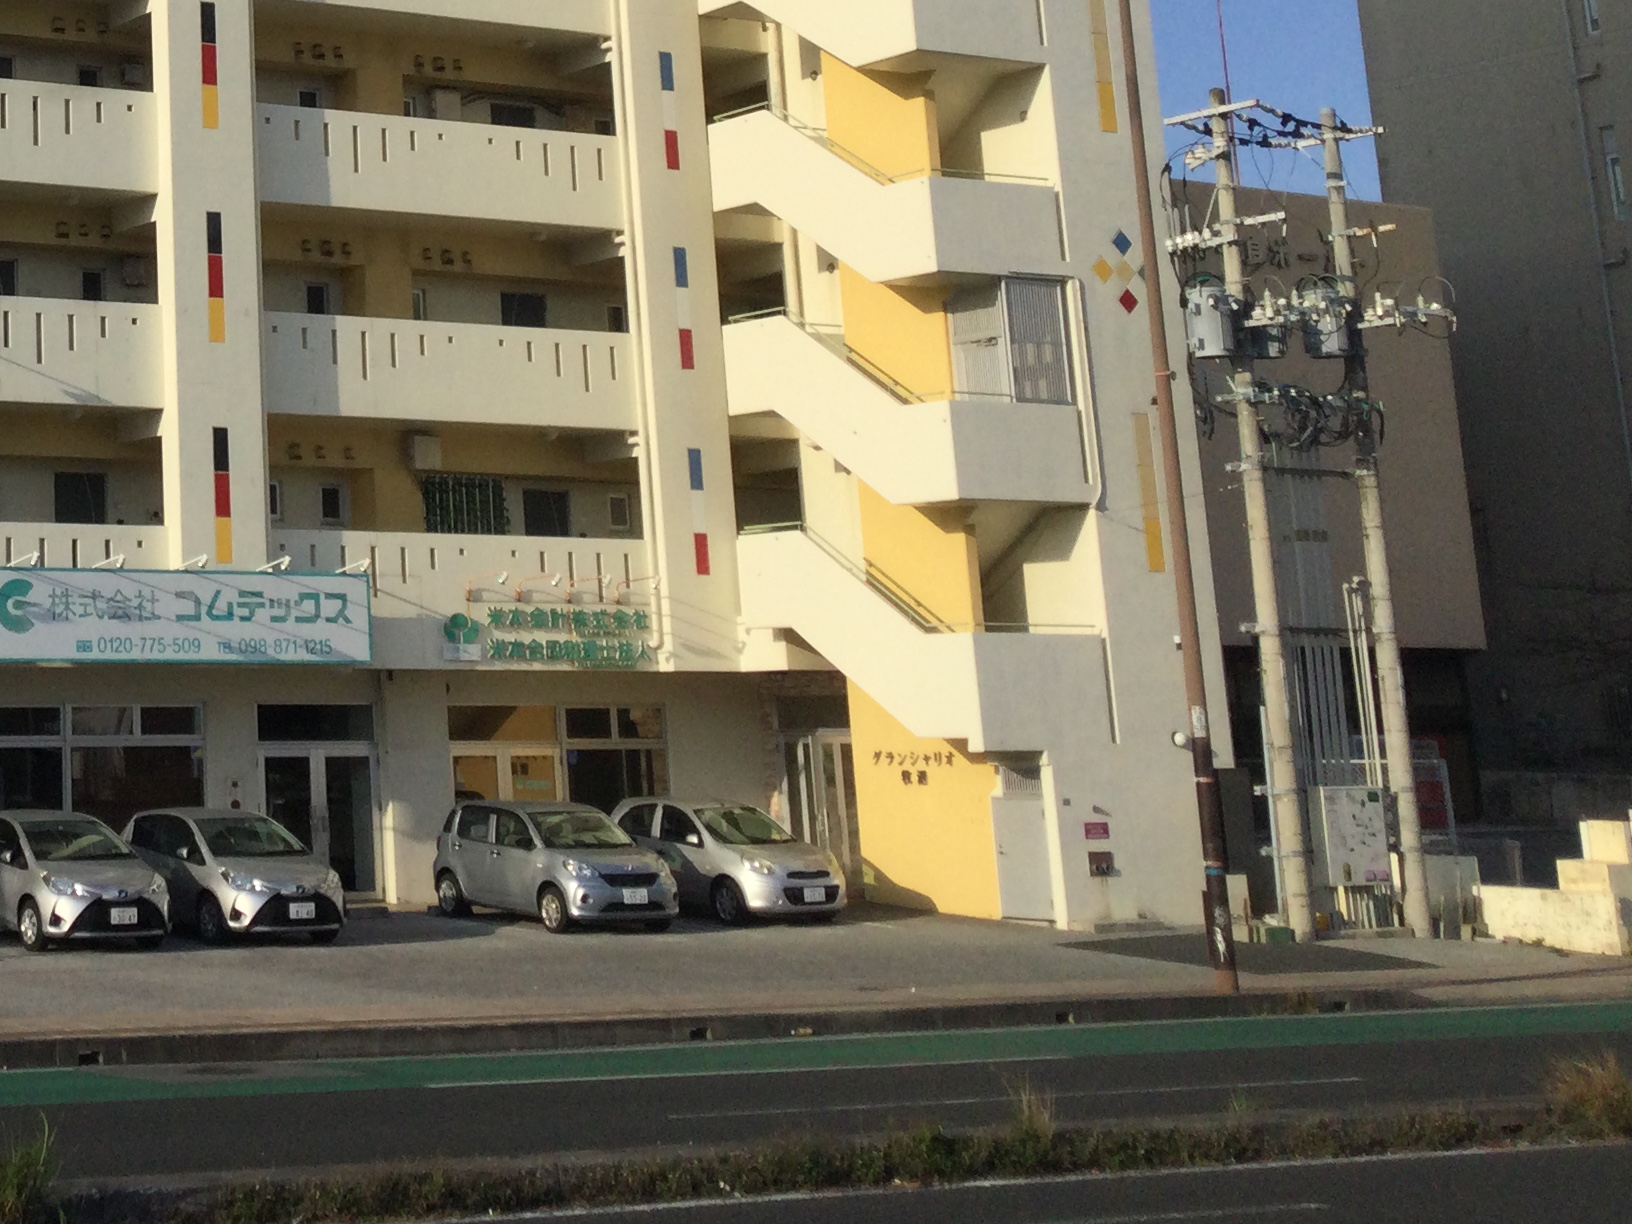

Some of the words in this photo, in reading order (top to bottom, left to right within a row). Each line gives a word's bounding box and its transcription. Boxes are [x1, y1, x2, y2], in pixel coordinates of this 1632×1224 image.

[48, 587, 161, 621] 株式会社
[174, 589, 354, 624] コムテックス
[97, 636, 201, 654] 0120-775-509
[238, 637, 333, 655] 098-871-1215
